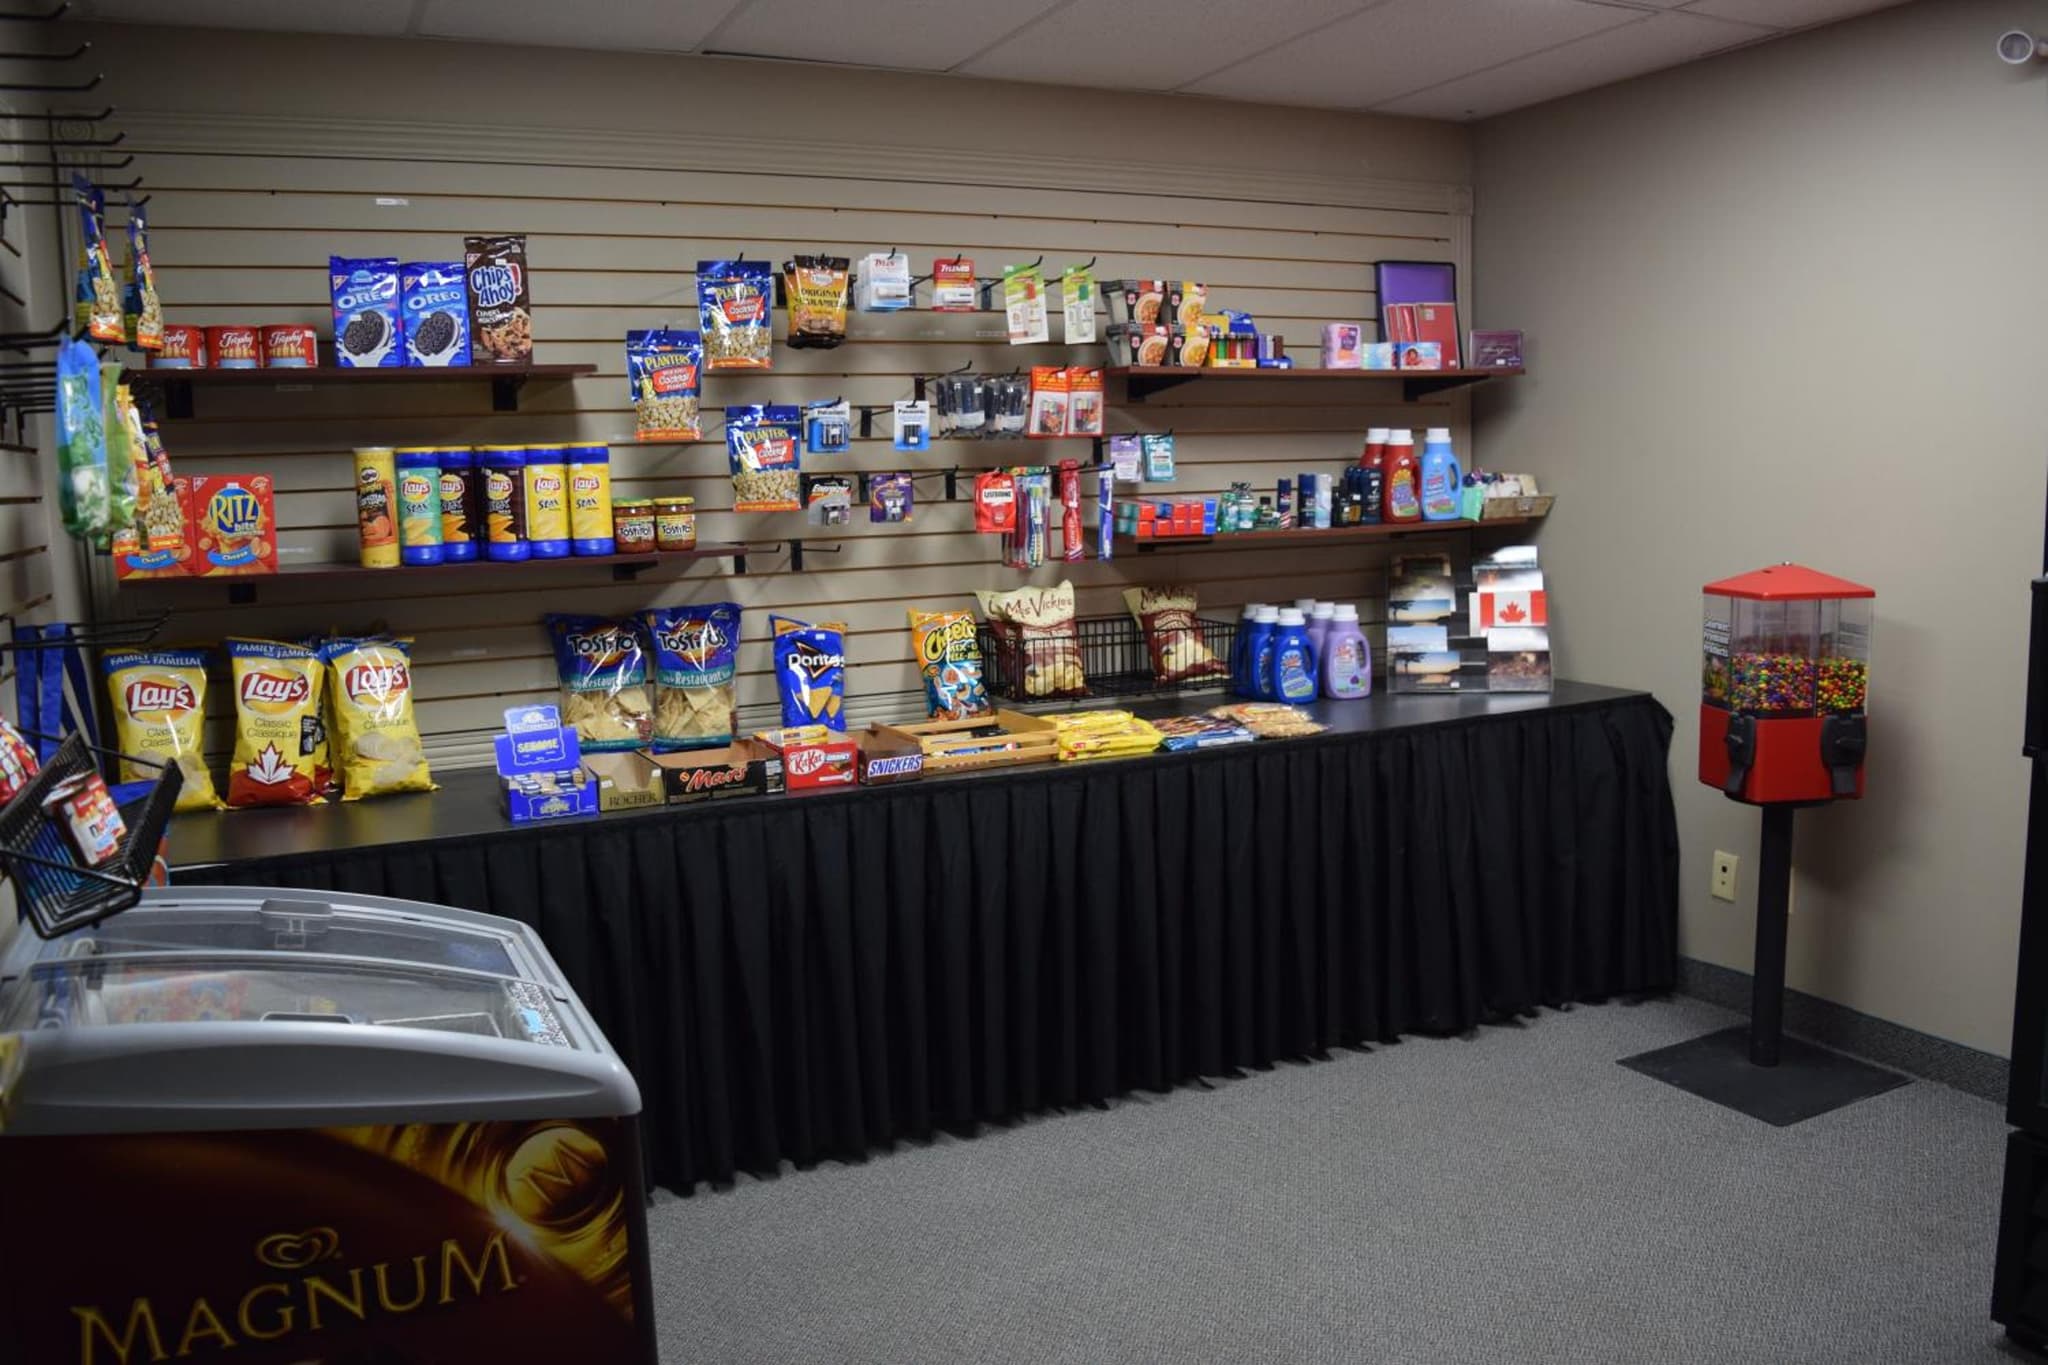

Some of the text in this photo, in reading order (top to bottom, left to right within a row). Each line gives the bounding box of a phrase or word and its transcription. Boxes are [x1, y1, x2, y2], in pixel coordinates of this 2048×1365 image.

[472, 266, 513, 292] Chips
[408, 291, 461, 309] OREO
[219, 331, 254, 347] Trophy
[268, 330, 304, 347] Trophy
[645, 354, 690, 369] PLANTERS
[744, 427, 789, 443] PLANTERS
[210, 493, 257, 528] RITZ
[924, 620, 977, 661] Cheeto
[244, 669, 308, 702] Lay's
[674, 669, 723, 685] Restaurant
[131, 680, 193, 712] Lay's
[254, 717, 292, 729] Classic
[246, 727, 298, 740] Classique
[869, 755, 921, 776] SNICKERS
[685, 766, 748, 793] Mars
[608, 792, 658, 808] ROCHER
[70, 1238, 519, 1365] MAGNUM
